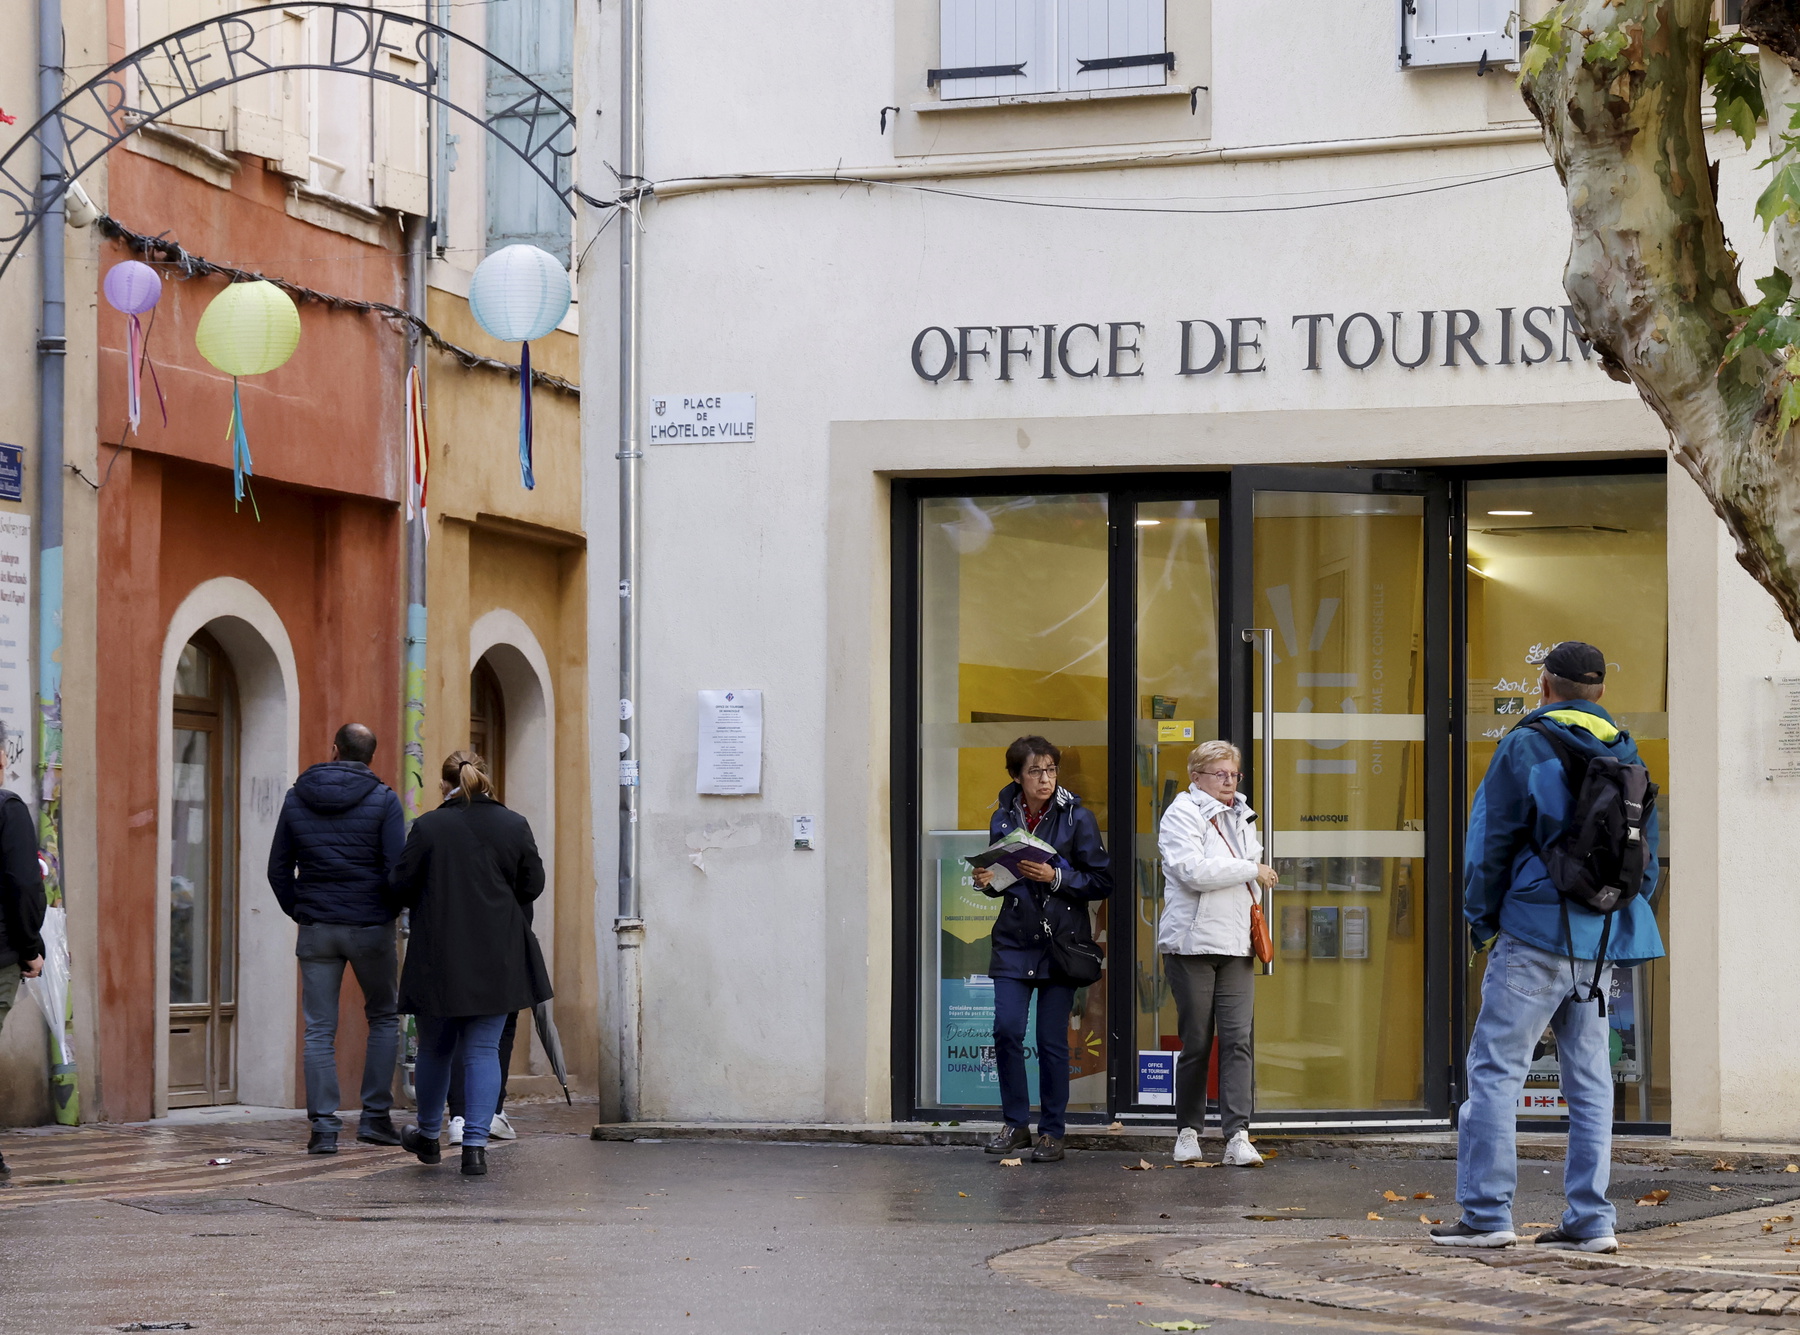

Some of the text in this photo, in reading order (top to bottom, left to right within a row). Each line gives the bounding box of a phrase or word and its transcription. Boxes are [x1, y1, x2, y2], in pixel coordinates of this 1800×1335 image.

[330, 8, 446, 88] DES
[486, 90, 577, 198] AR
[911, 305, 1597, 383] OFFICE DE TOURISM
[683, 397, 721, 410] PLACE
[696, 412, 708, 421] DE
[651, 421, 754, 438] L'HÔTEL DE VILLE
[1373, 583, 1384, 656] CONSEILLE
[1373, 659, 1383, 680] ON
[1497, 697, 1516, 715] et
[1372, 752, 1383, 775] ON
[1300, 814, 1349, 823] MANOSQUE
[944, 1022, 995, 1041] Destina
[947, 1064, 992, 1073] DURANCE
